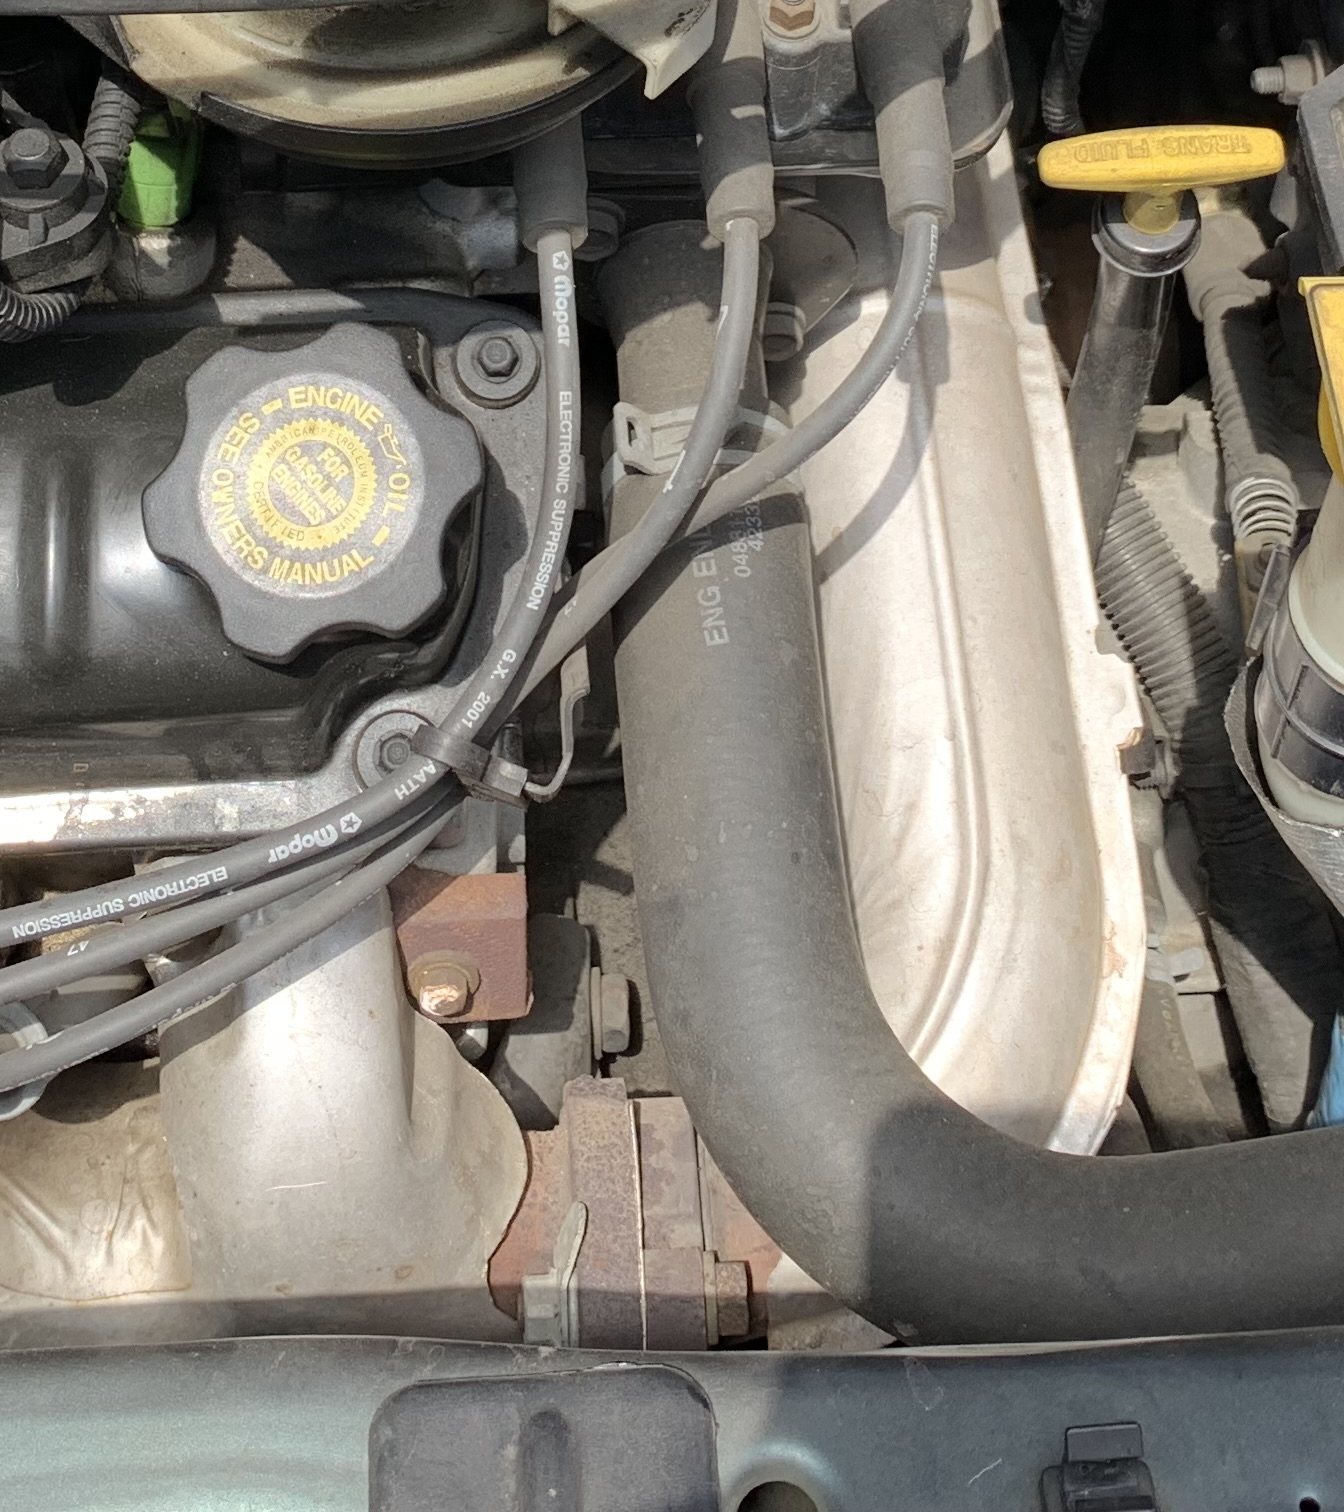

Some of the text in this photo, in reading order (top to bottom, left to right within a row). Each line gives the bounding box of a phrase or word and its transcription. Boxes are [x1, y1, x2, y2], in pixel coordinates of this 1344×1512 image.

[1074, 139, 1150, 164] FLUID
[287, 385, 411, 517] ENGINE OIL
[316, 447, 350, 482] FOR
[556, 390, 573, 494] ELECTRONIC
[211, 412, 375, 585] SEE OWNERS MANUAL
[270, 464, 325, 526] ENGINES
[283, 445, 347, 517] GASOLINE
[525, 499, 568, 611] SUPPRESSION
[698, 586, 730, 646] ENG
[490, 648, 517, 680] G.X.
[460, 691, 491, 729] 2001
[393, 758, 438, 801] AATH
[127, 866, 228, 910] ELECTRONIC
[11, 896, 125, 939] SUPPRESSION
